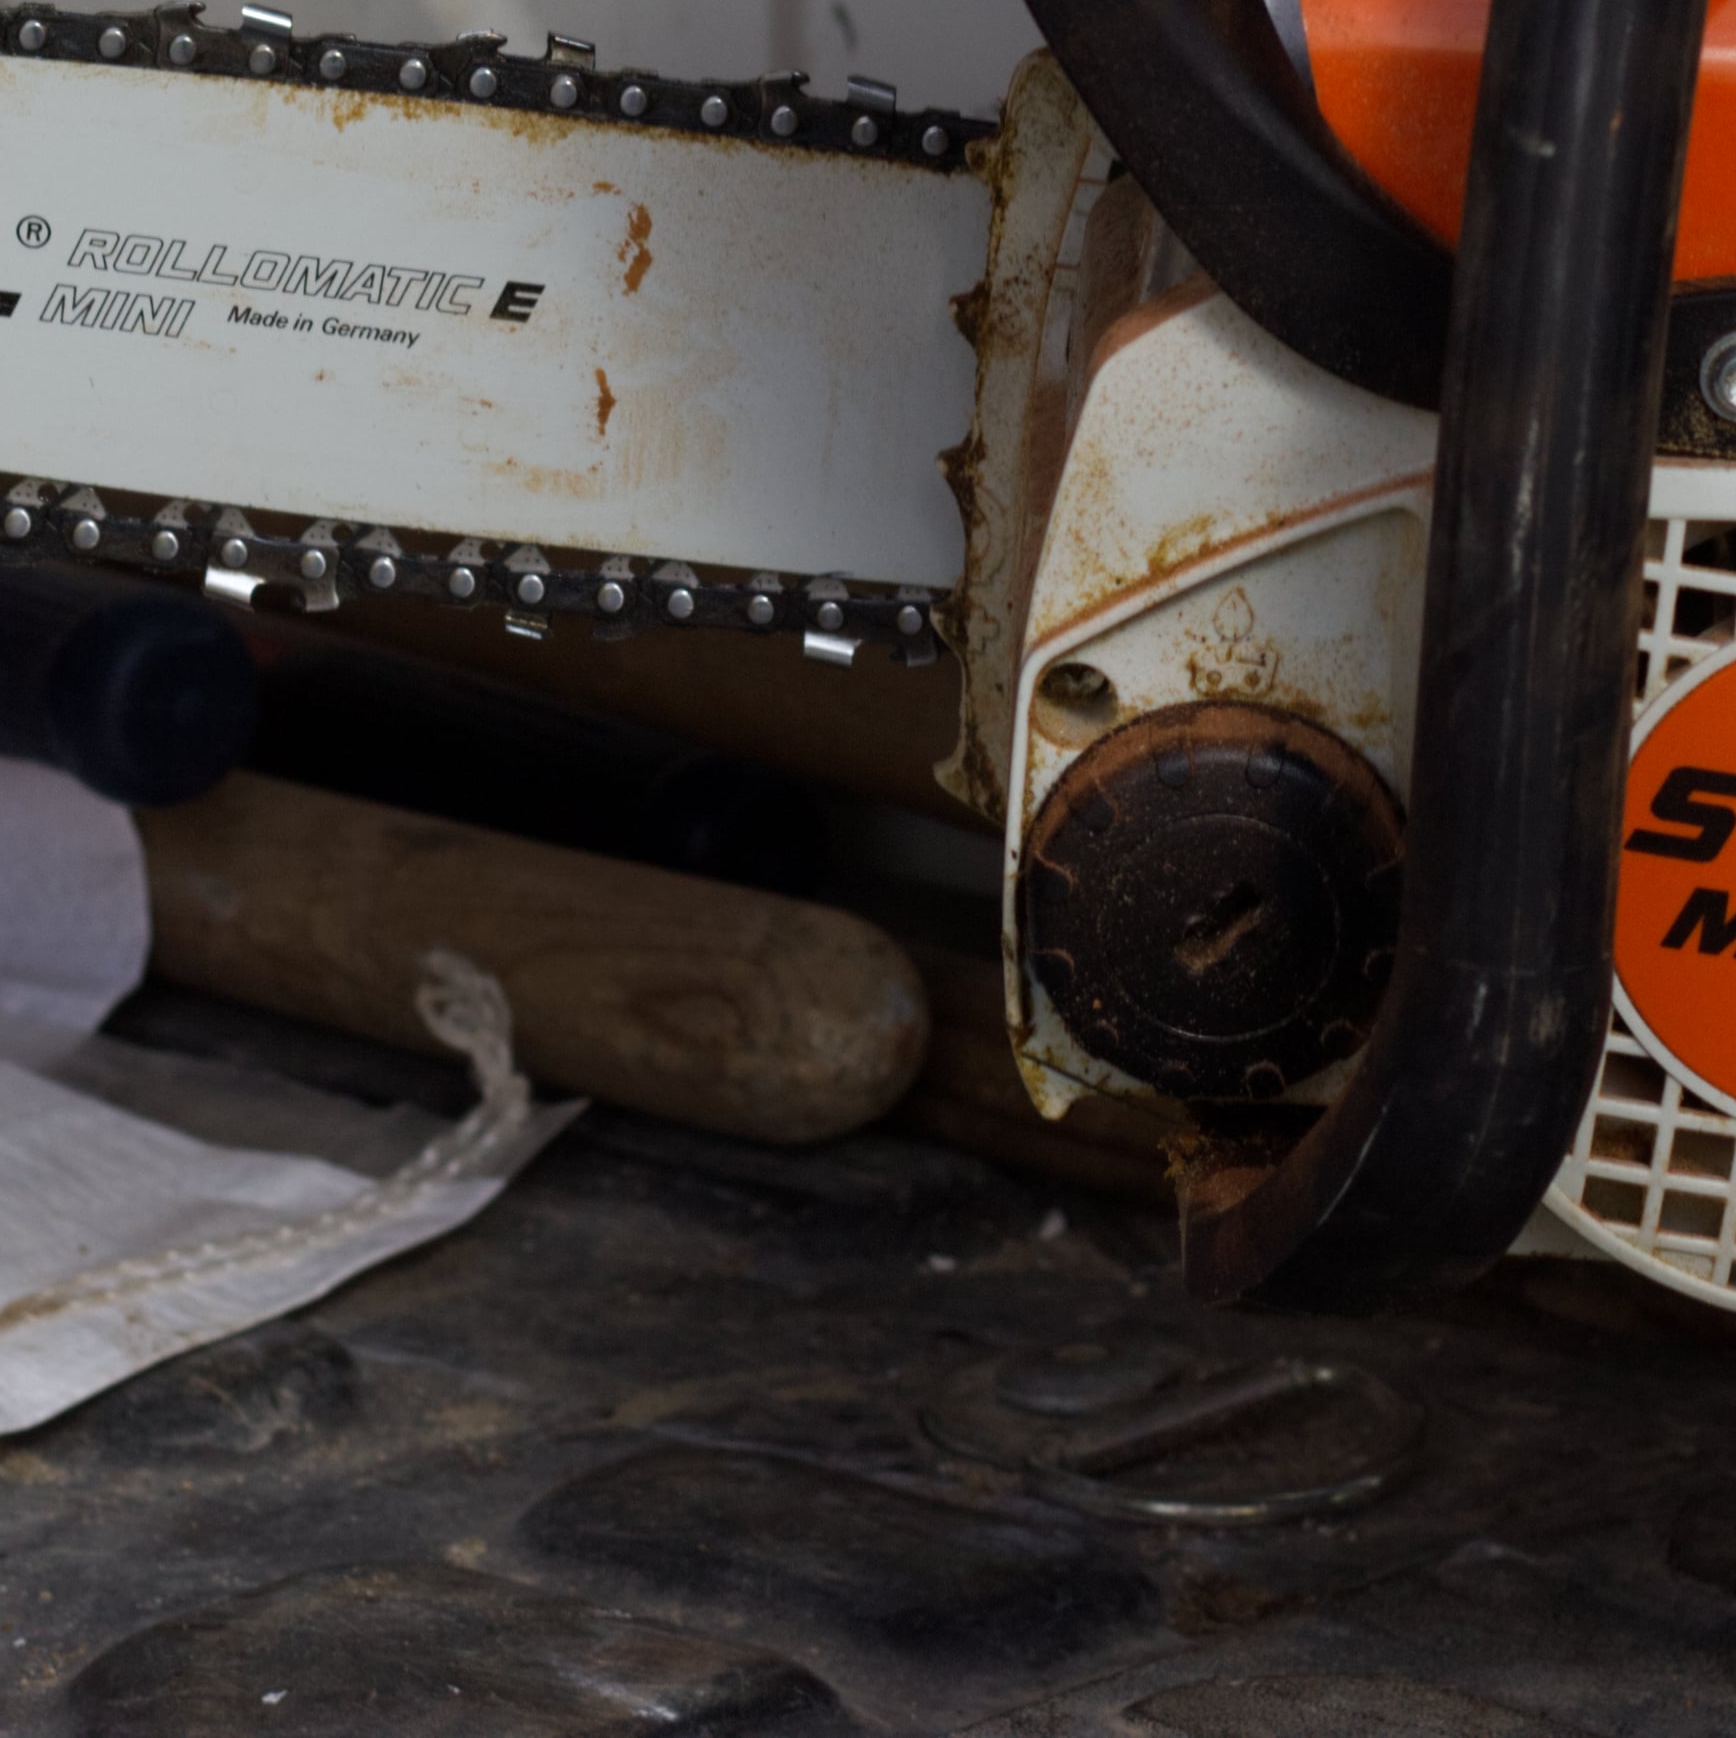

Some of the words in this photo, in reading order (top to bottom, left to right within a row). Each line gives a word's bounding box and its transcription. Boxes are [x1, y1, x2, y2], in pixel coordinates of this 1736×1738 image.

[66, 228, 486, 316] ROLLOMATIC
[489, 280, 547, 324] E
[38, 283, 197, 338] MINI
[226, 304, 290, 330] Made
[292, 314, 314, 333] in
[321, 316, 421, 350] Germany
